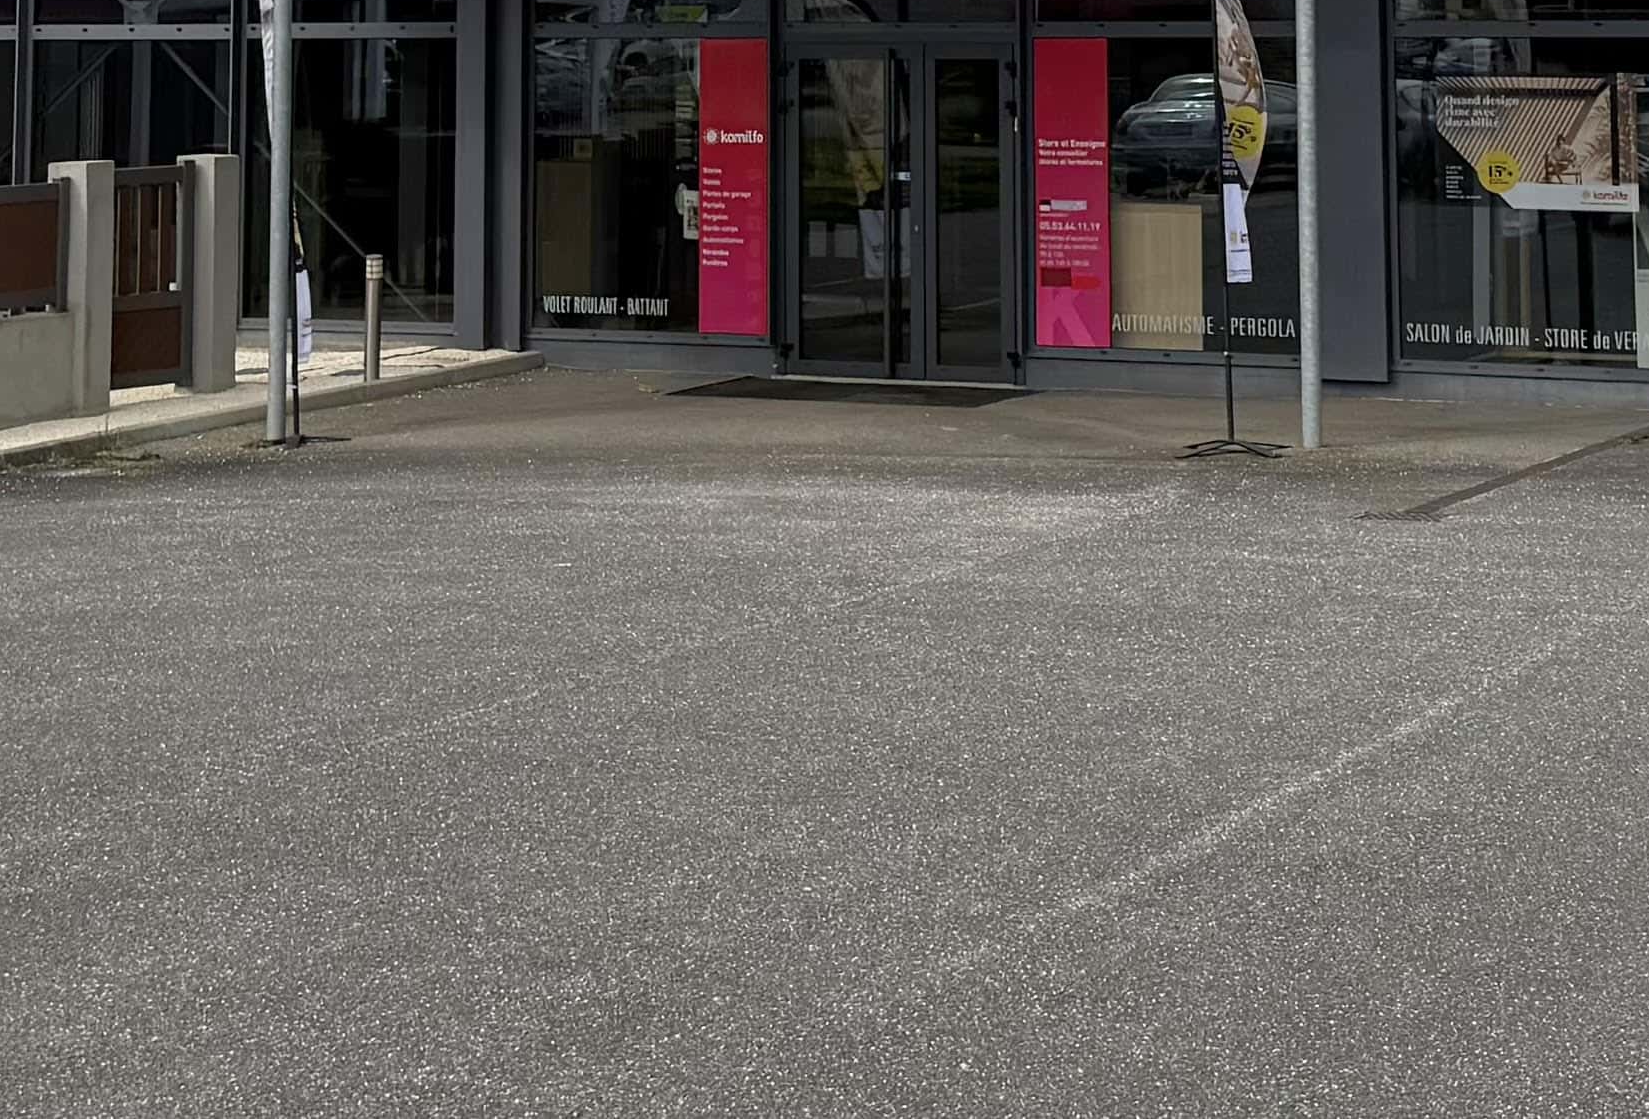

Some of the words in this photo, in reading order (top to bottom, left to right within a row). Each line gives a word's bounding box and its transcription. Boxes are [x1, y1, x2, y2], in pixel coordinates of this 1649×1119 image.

[720, 130, 764, 144] komilfo
[543, 295, 572, 313] VOLET
[573, 296, 618, 315] ROULANT
[627, 297, 669, 317] BATTANT
[1112, 314, 1215, 335] AUTOMATISME
[1230, 317, 1296, 338] PERGOLA
[1406, 323, 1450, 343] SALON
[1455, 326, 1472, 344] de
[1476, 325, 1530, 347] JARDIN
[1544, 328, 1588, 349] STORE
